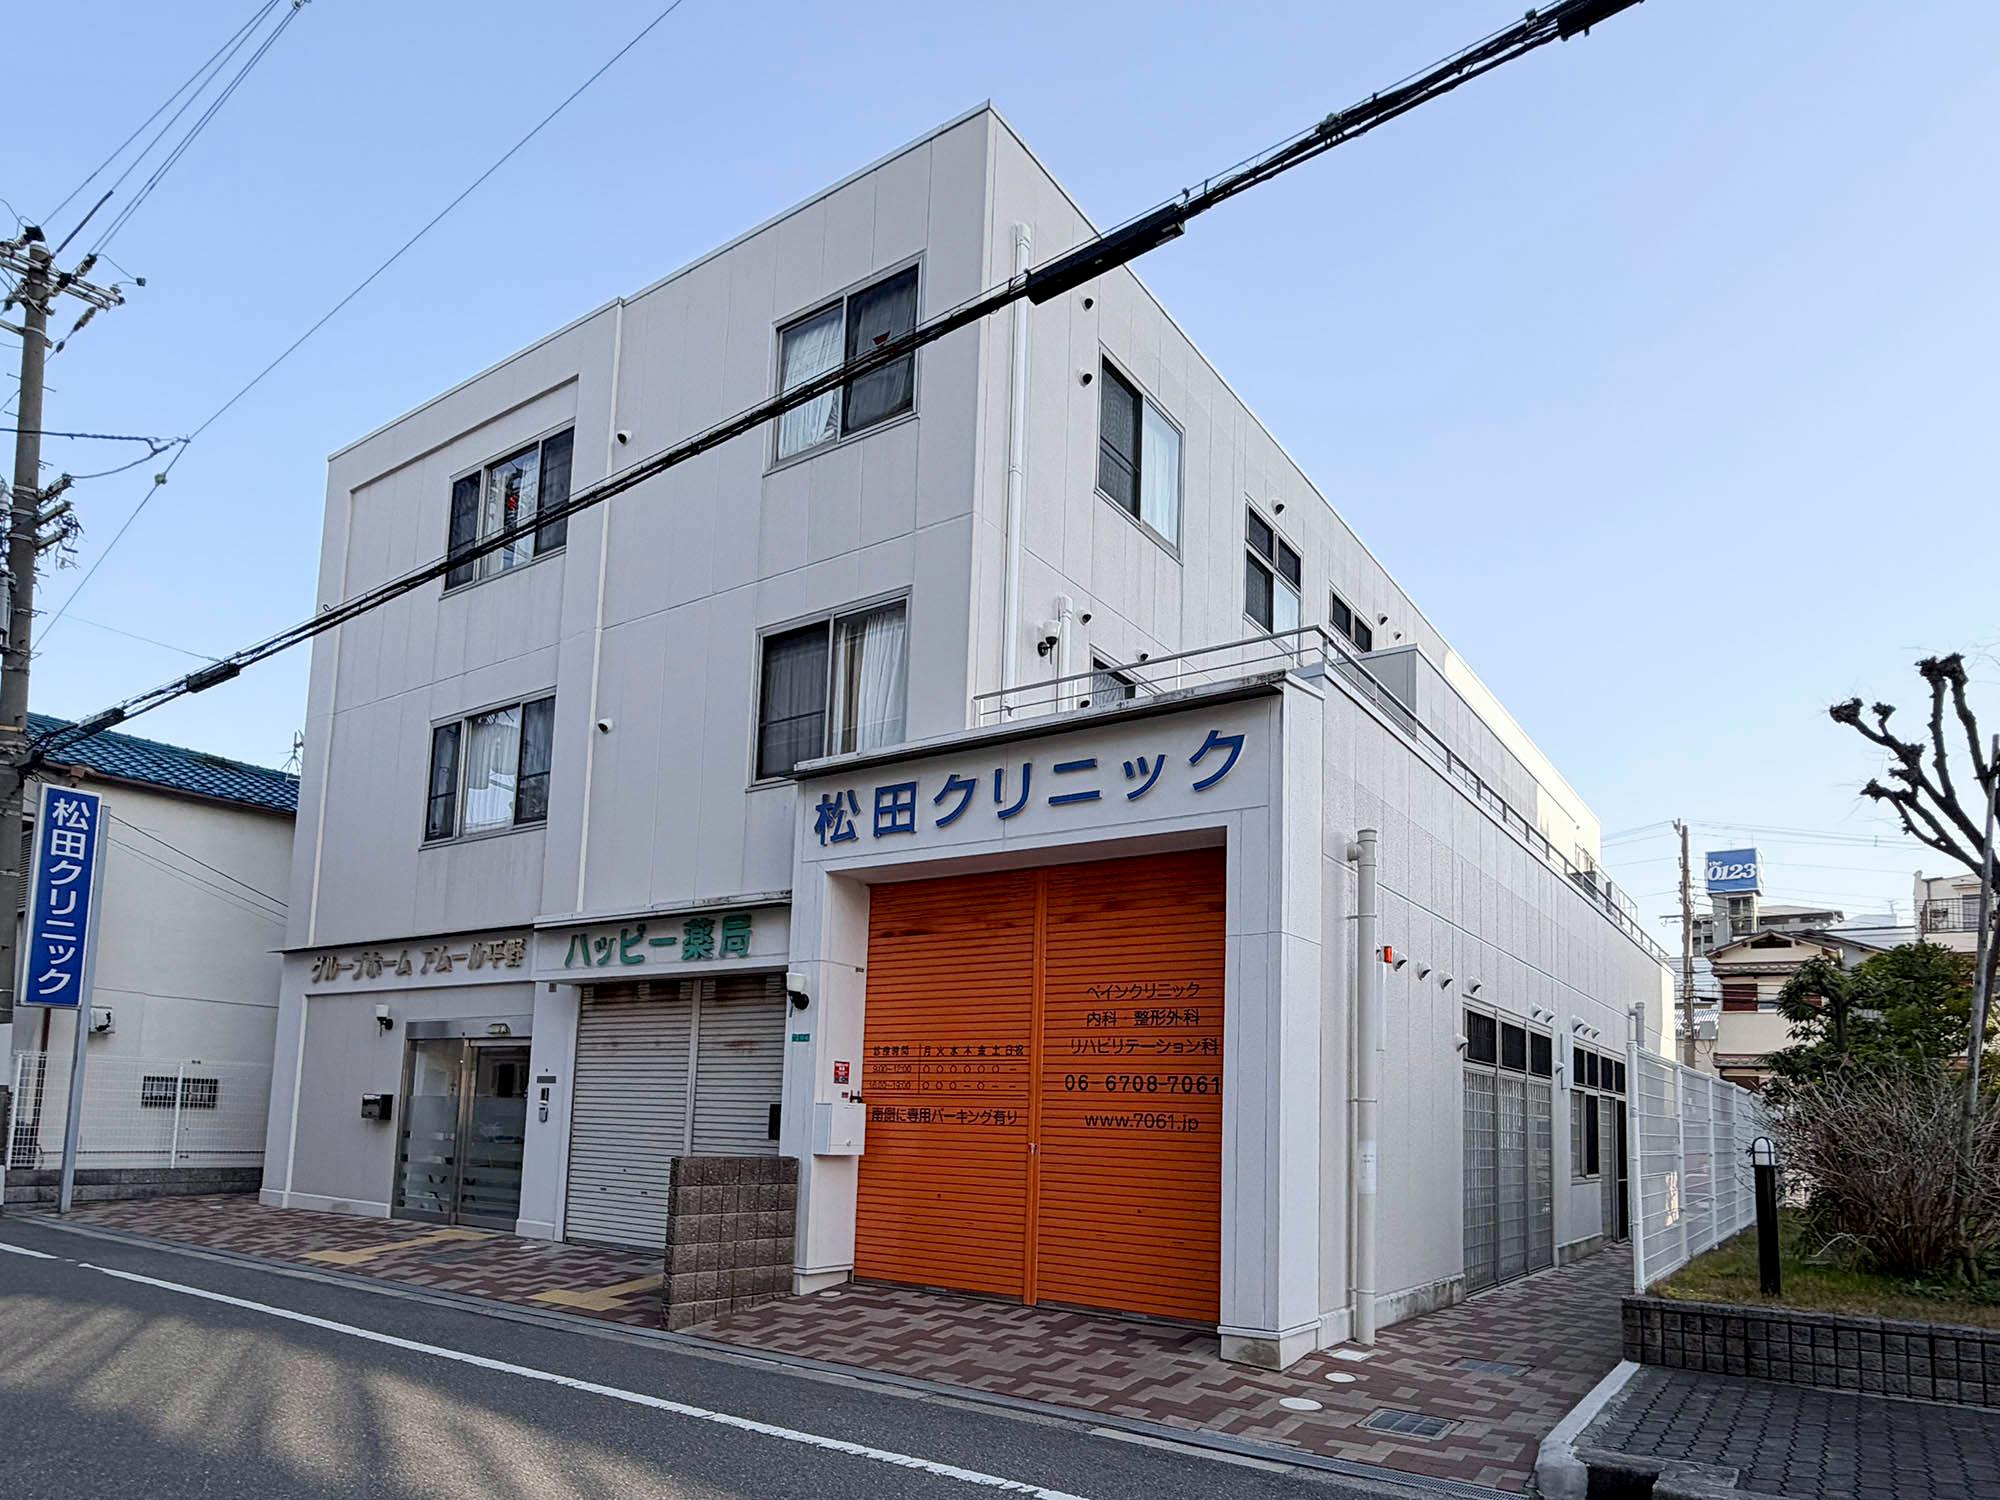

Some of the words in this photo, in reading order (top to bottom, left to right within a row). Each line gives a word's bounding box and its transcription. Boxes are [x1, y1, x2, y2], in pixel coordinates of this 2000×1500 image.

[814, 729, 1247, 847] 松田クリニック
[1707, 863, 1757, 881] 0123
[38, 797, 90, 995] 松田クリニック
[564, 913, 753, 968] ハッピー薬局
[311, 949, 413, 984] グループホーム
[419, 937, 527, 975] アムール平野
[1087, 981, 1201, 1001] ペインクリニック
[1086, 1008, 1200, 1028] 内科・整形外科
[1070, 1037, 1220, 1056] リハビリテーション科
[1064, 1074, 1221, 1096] 06-6708-7061
[871, 1107, 1018, 1126] 南側に専用パーキング有り
[1084, 1112, 1200, 1133] www.7061.jp
